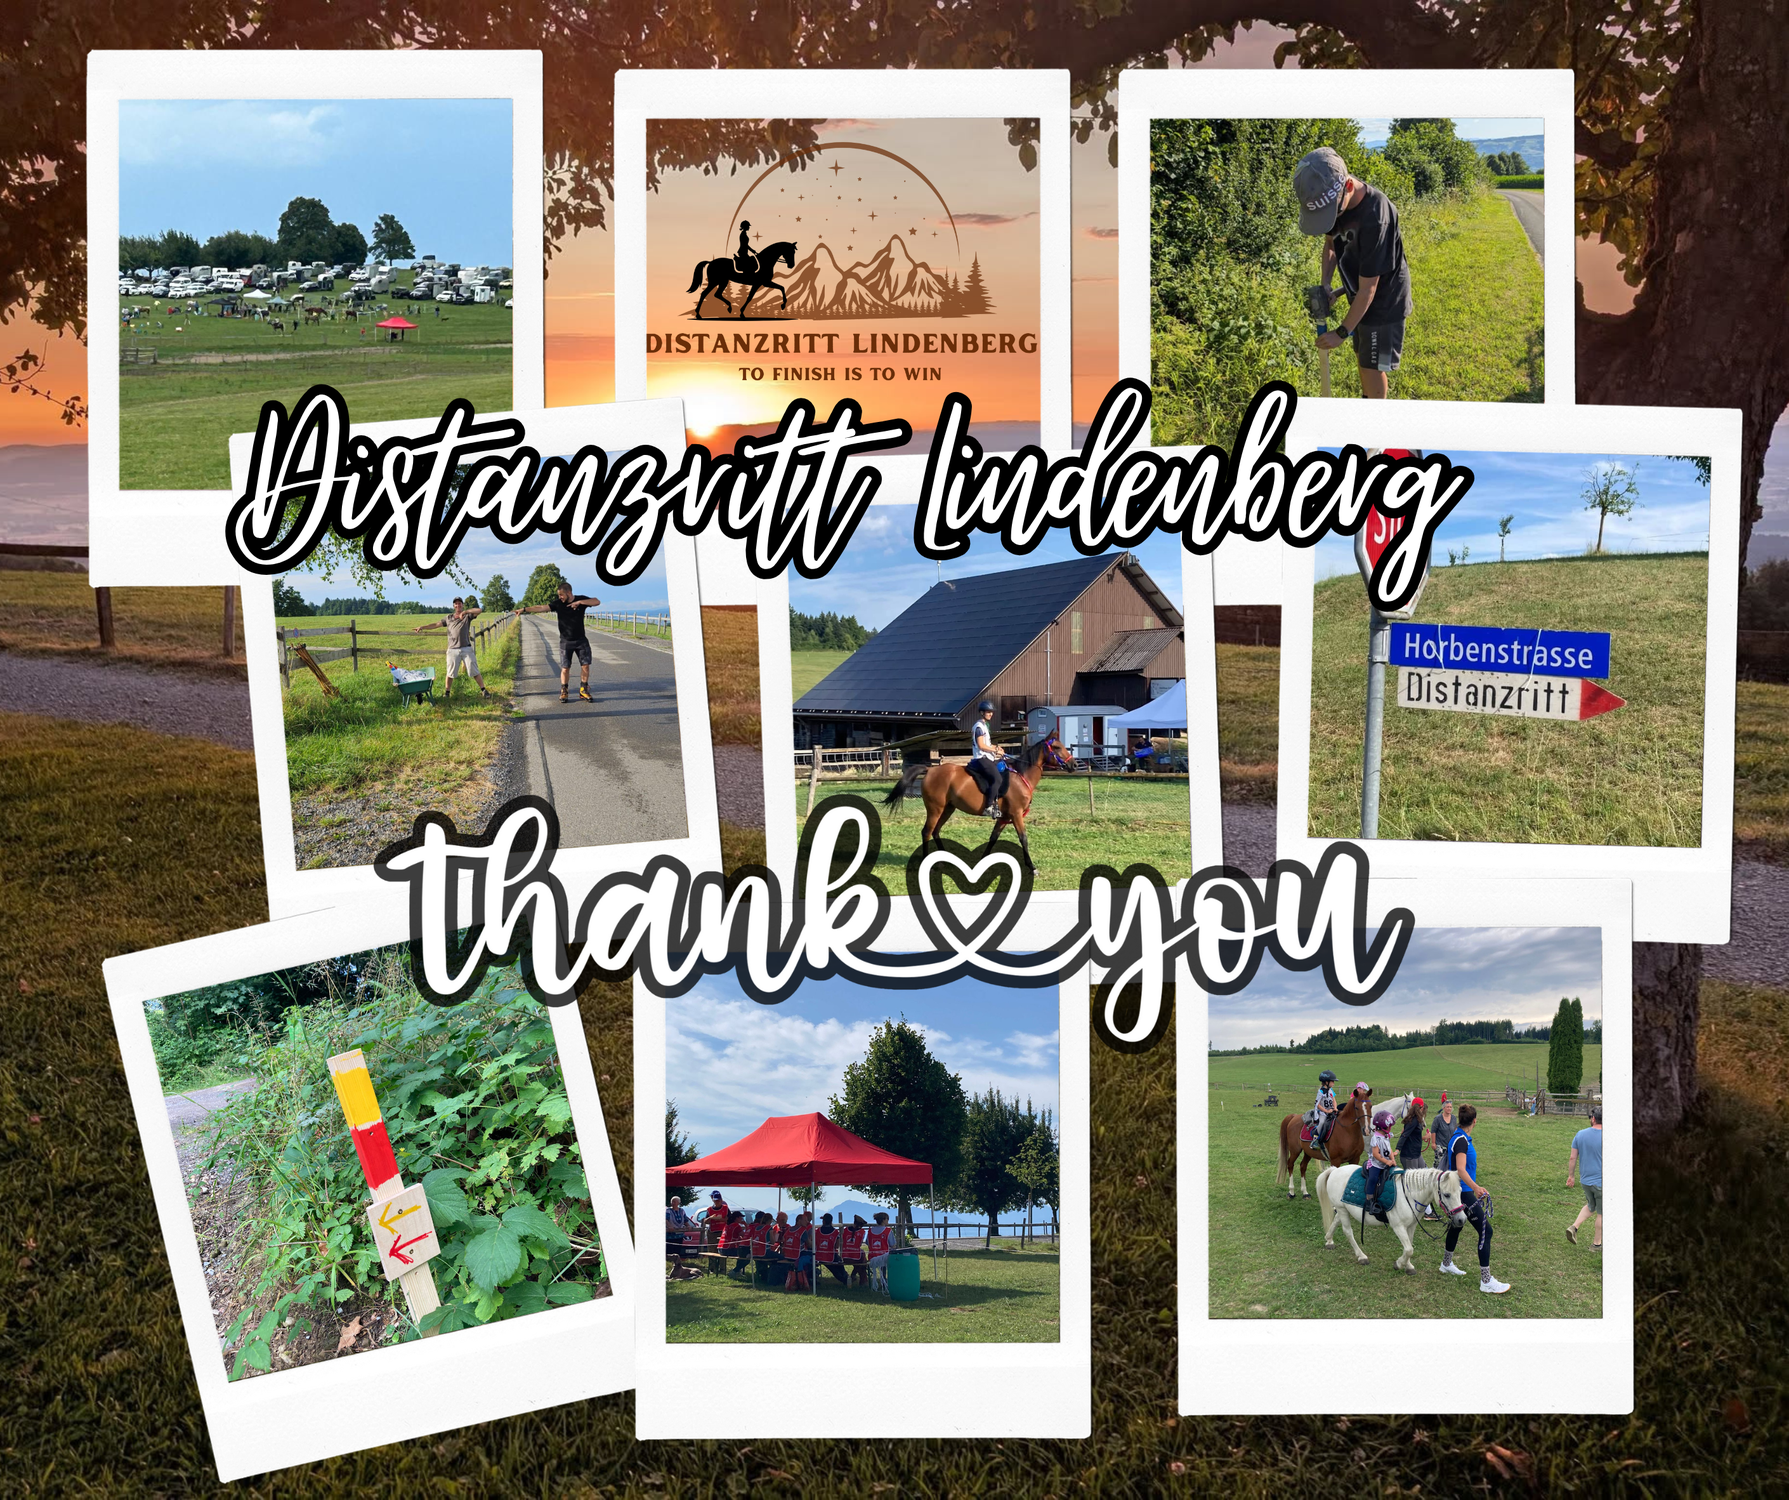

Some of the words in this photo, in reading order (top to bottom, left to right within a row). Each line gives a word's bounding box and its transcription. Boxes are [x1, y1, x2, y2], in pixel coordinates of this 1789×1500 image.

[1306, 173, 1346, 211] suisse
[646, 333, 839, 354] DISTANZRITT
[853, 333, 1038, 354] LINDENBERG
[738, 367, 764, 381] TO
[772, 367, 836, 381] FINISH
[844, 367, 863, 381] IS
[869, 367, 896, 381] TO
[904, 367, 942, 381] WIN
[1404, 632, 1594, 670] Horbenstrasse
[1406, 671, 1570, 714] Distanzritt
